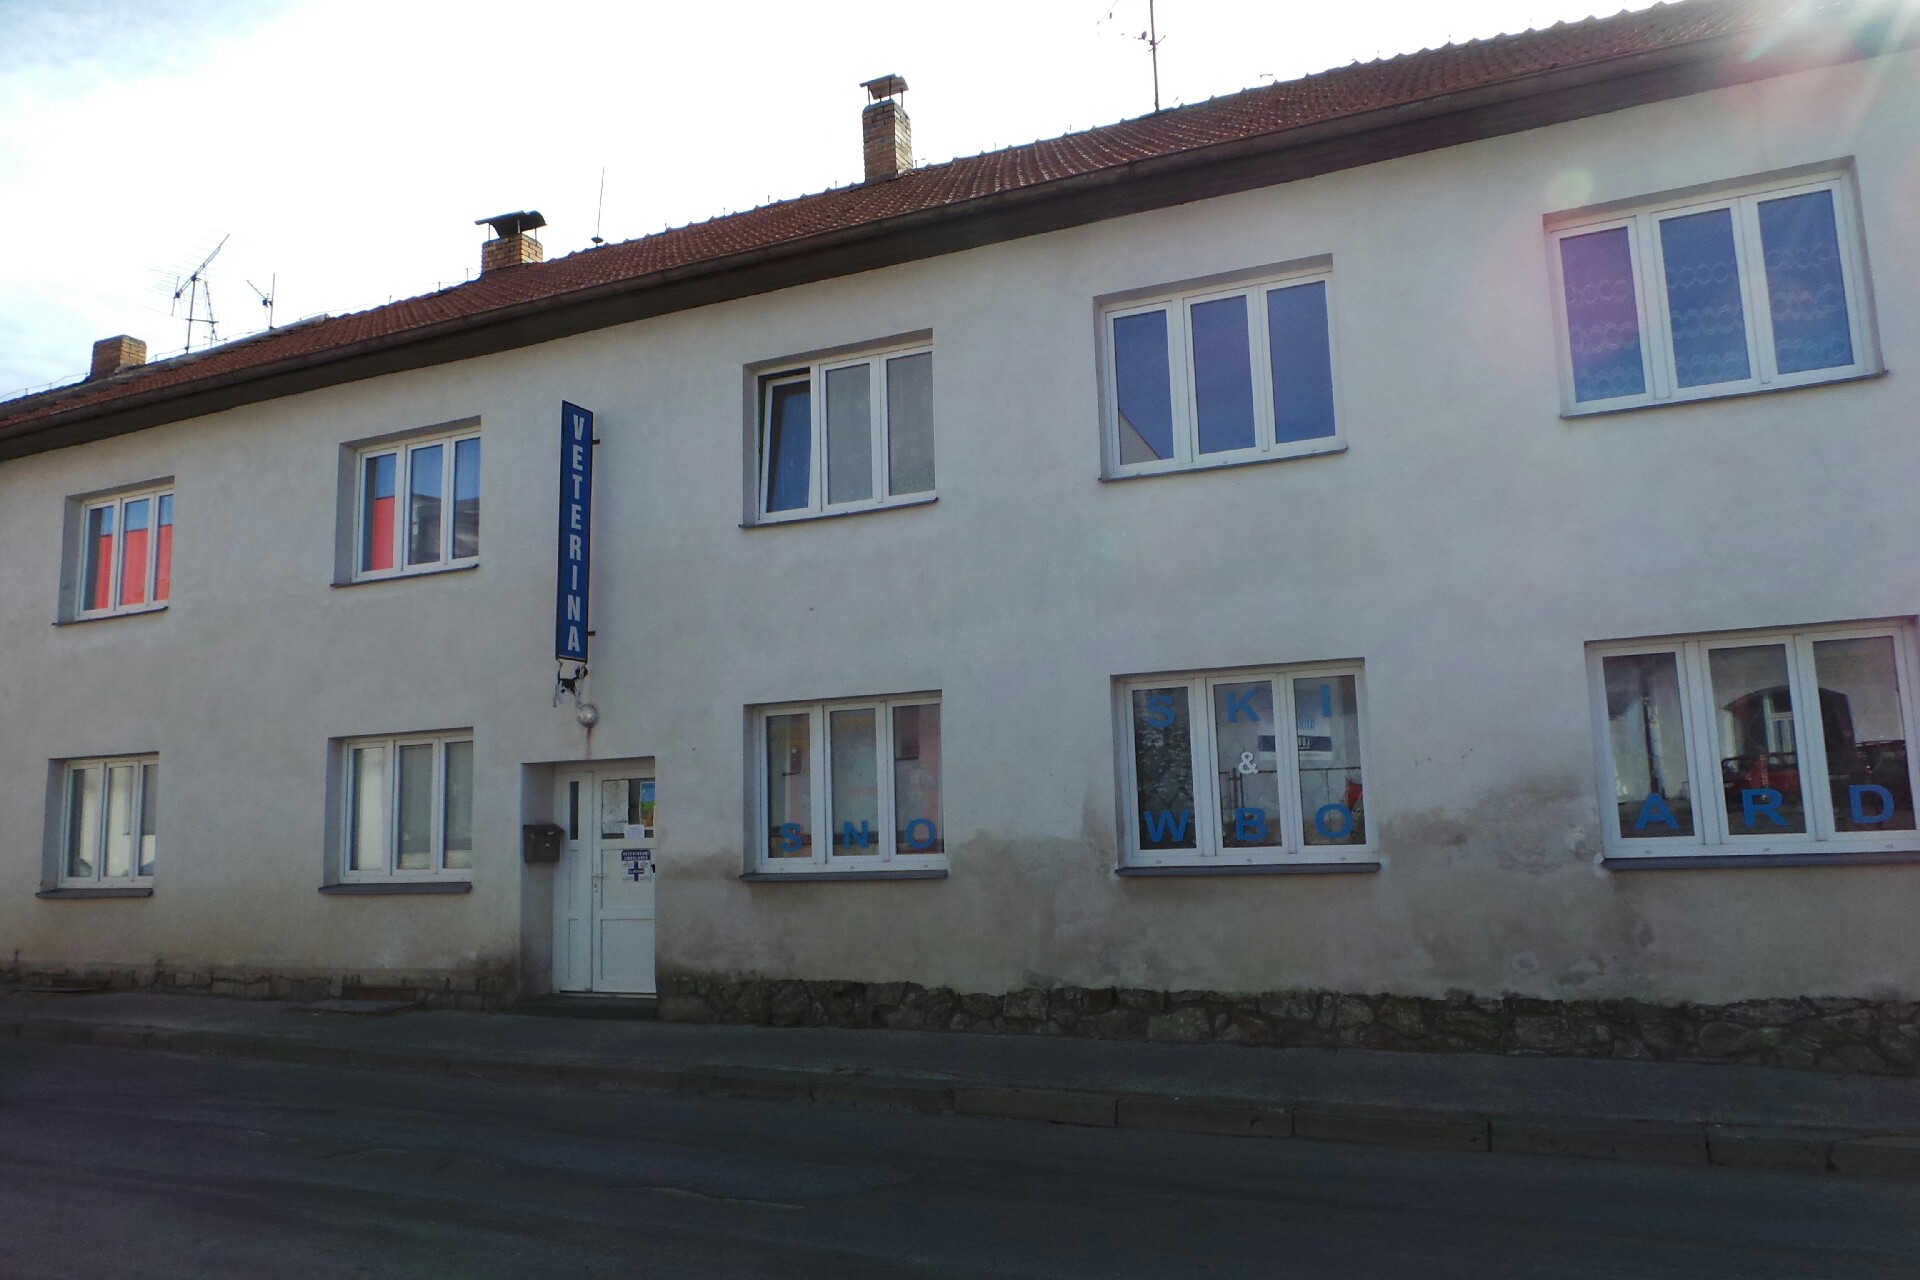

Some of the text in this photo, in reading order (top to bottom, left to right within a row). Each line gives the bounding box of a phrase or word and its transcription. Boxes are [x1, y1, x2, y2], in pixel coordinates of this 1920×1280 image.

[567, 414, 585, 653] VETERINA
[1146, 684, 1331, 729] SKI
[1238, 751, 1259, 775] &
